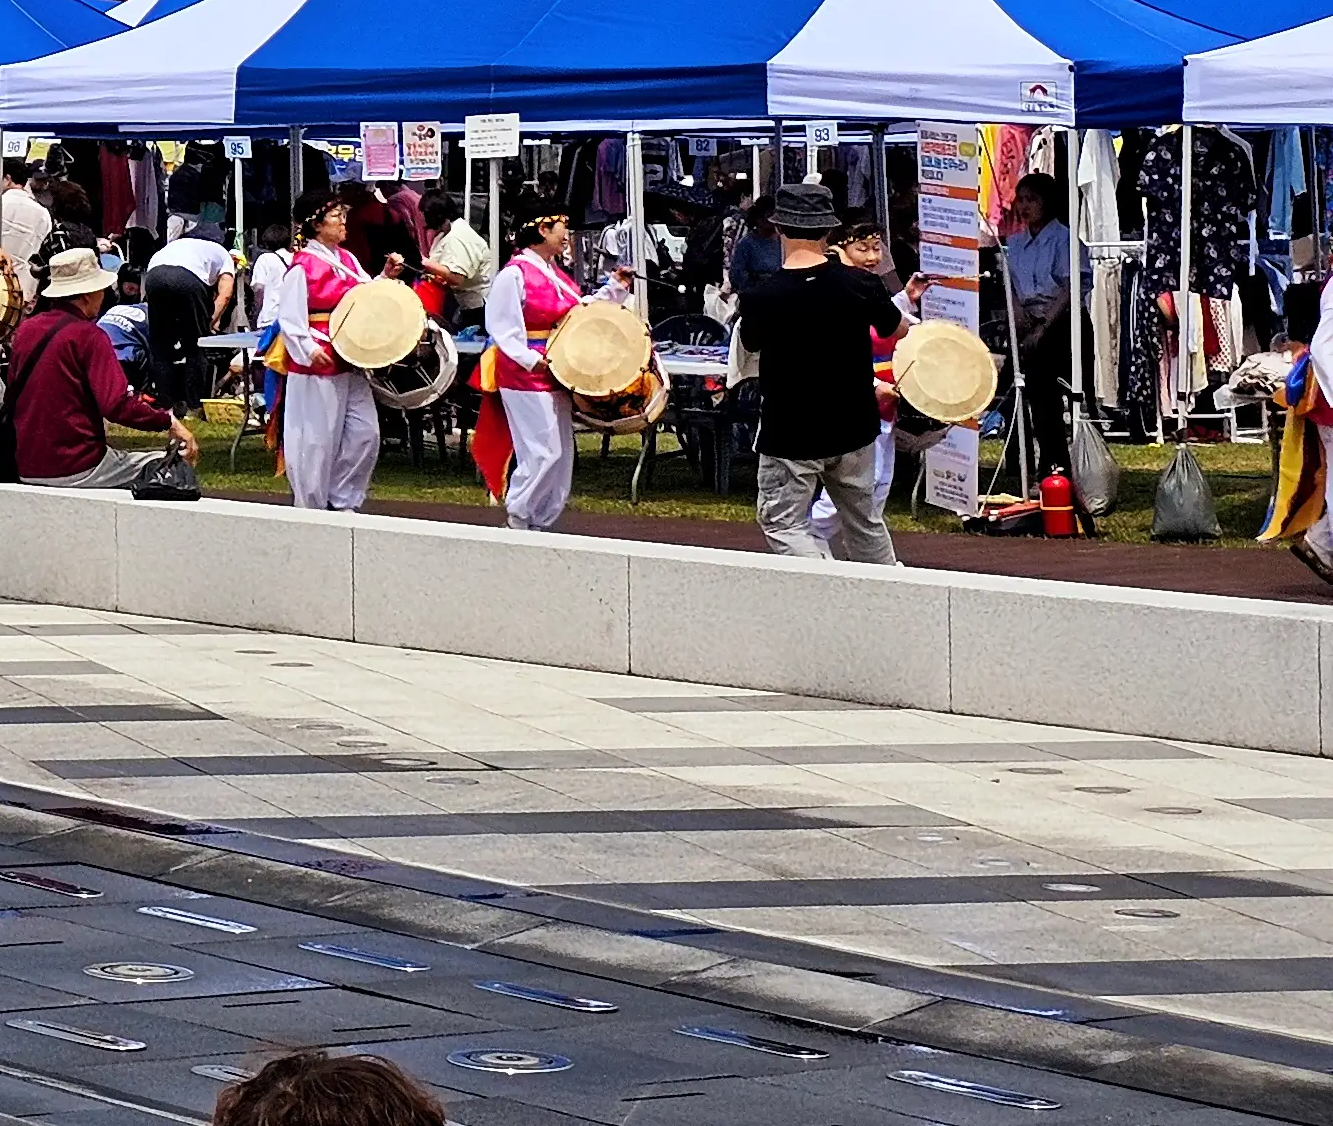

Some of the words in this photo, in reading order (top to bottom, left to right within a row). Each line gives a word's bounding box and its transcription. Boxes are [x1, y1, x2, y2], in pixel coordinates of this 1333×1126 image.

[814, 128, 830, 143] 93
[229, 141, 245, 156] 95
[695, 139, 710, 152] 82
